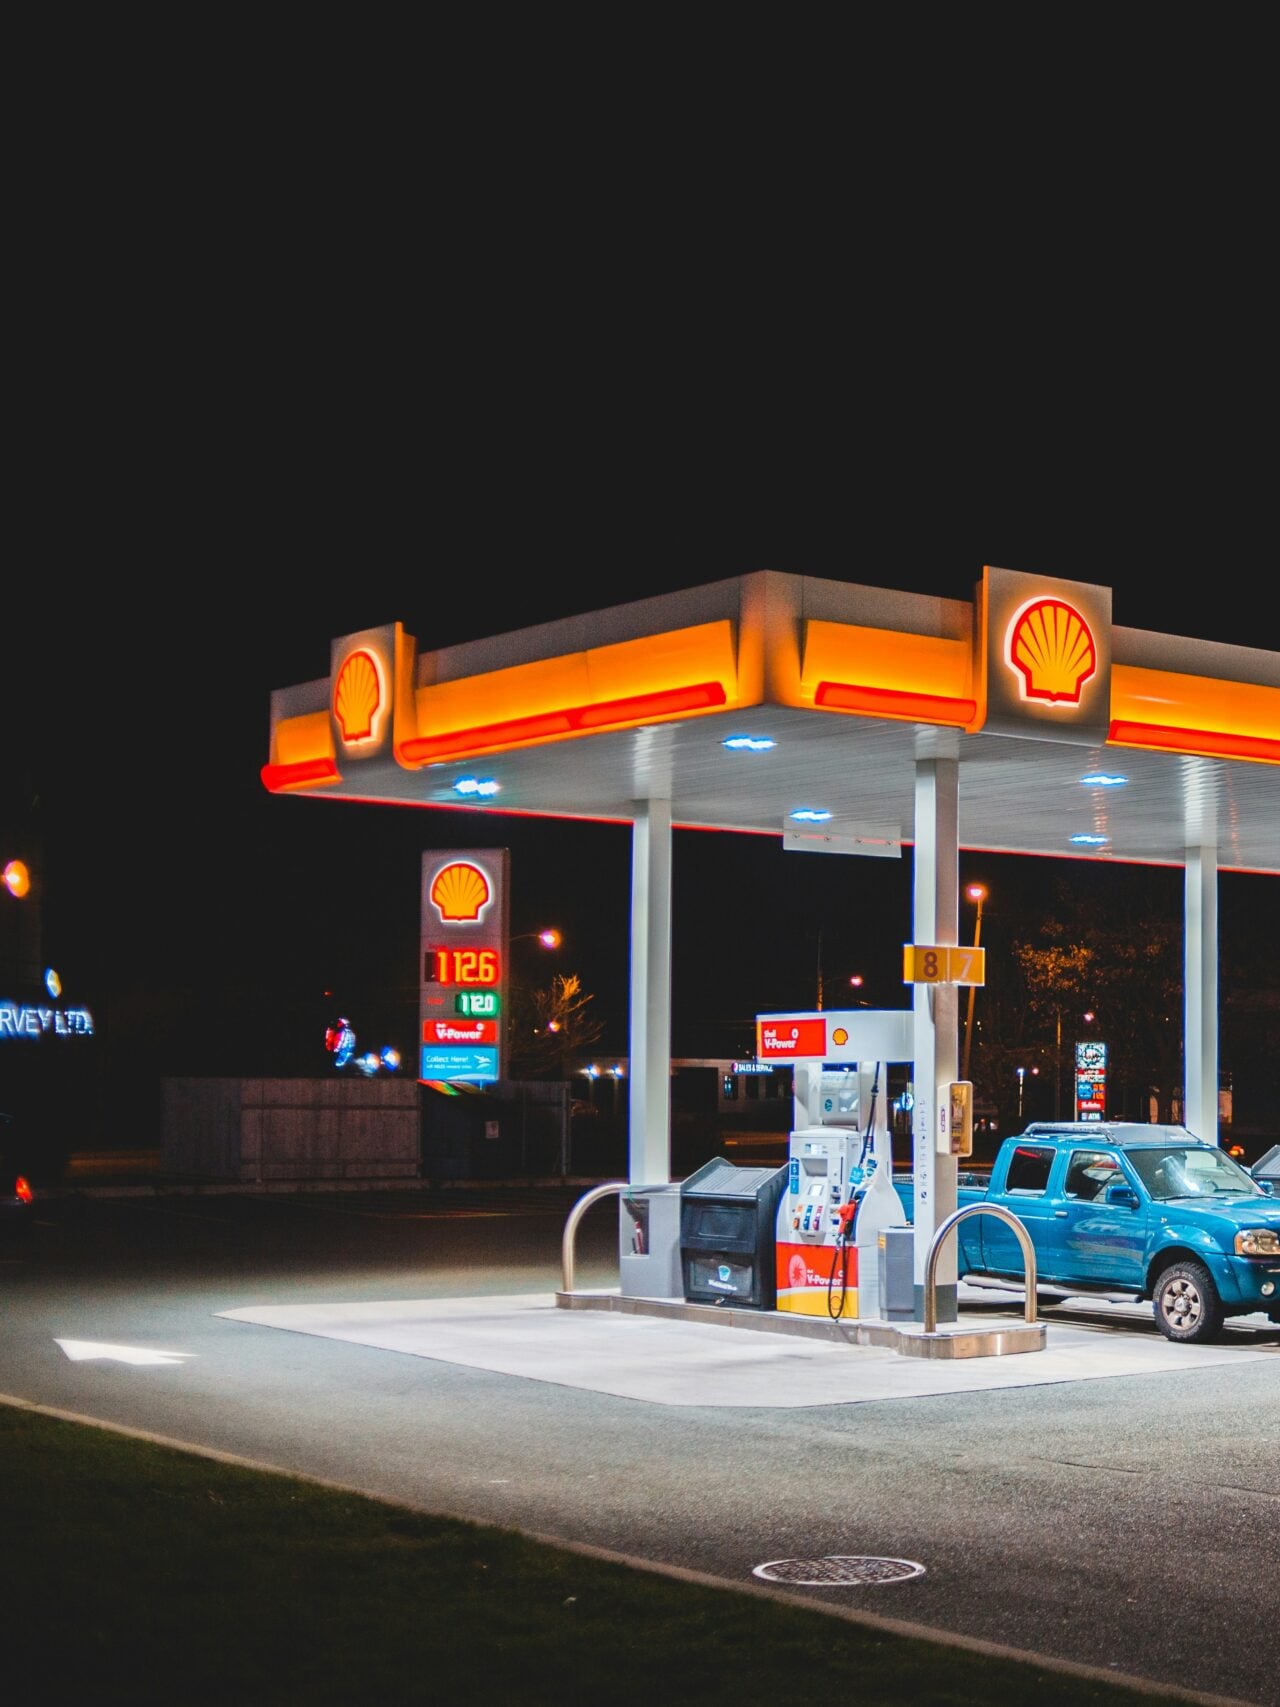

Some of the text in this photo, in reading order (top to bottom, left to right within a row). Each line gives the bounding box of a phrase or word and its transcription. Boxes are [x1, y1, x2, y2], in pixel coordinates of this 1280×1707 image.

[923, 951, 938, 978] 8
[959, 953, 974, 979] 7
[0, 1008, 53, 1033] RVEY
[436, 1028, 482, 1040] V-Power
[764, 1038, 796, 1049] V-Power
[426, 1055, 469, 1063] Collect Here!
